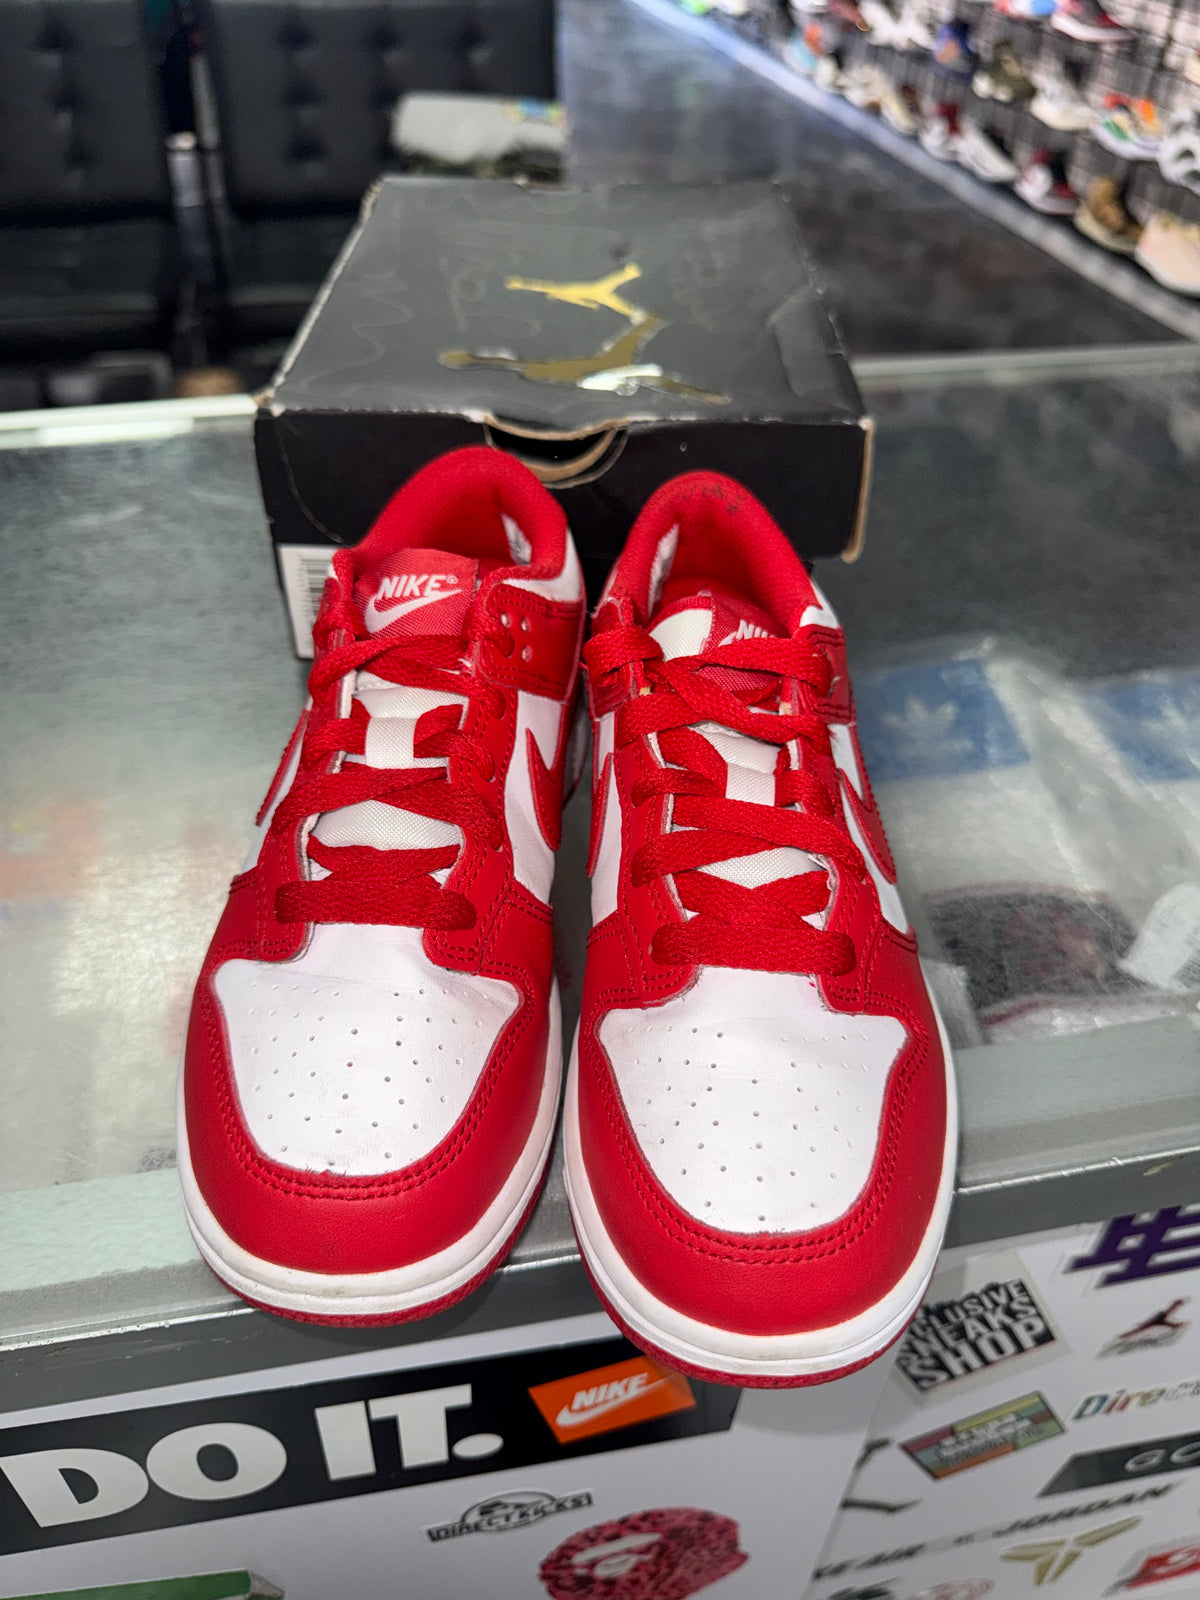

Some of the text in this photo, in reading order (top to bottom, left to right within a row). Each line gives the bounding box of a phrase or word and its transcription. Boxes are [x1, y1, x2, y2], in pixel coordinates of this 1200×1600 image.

[907, 1315, 1045, 1388] SHOP
[570, 1371, 649, 1411] NIKE
[0, 1383, 504, 1529] DO IT.
